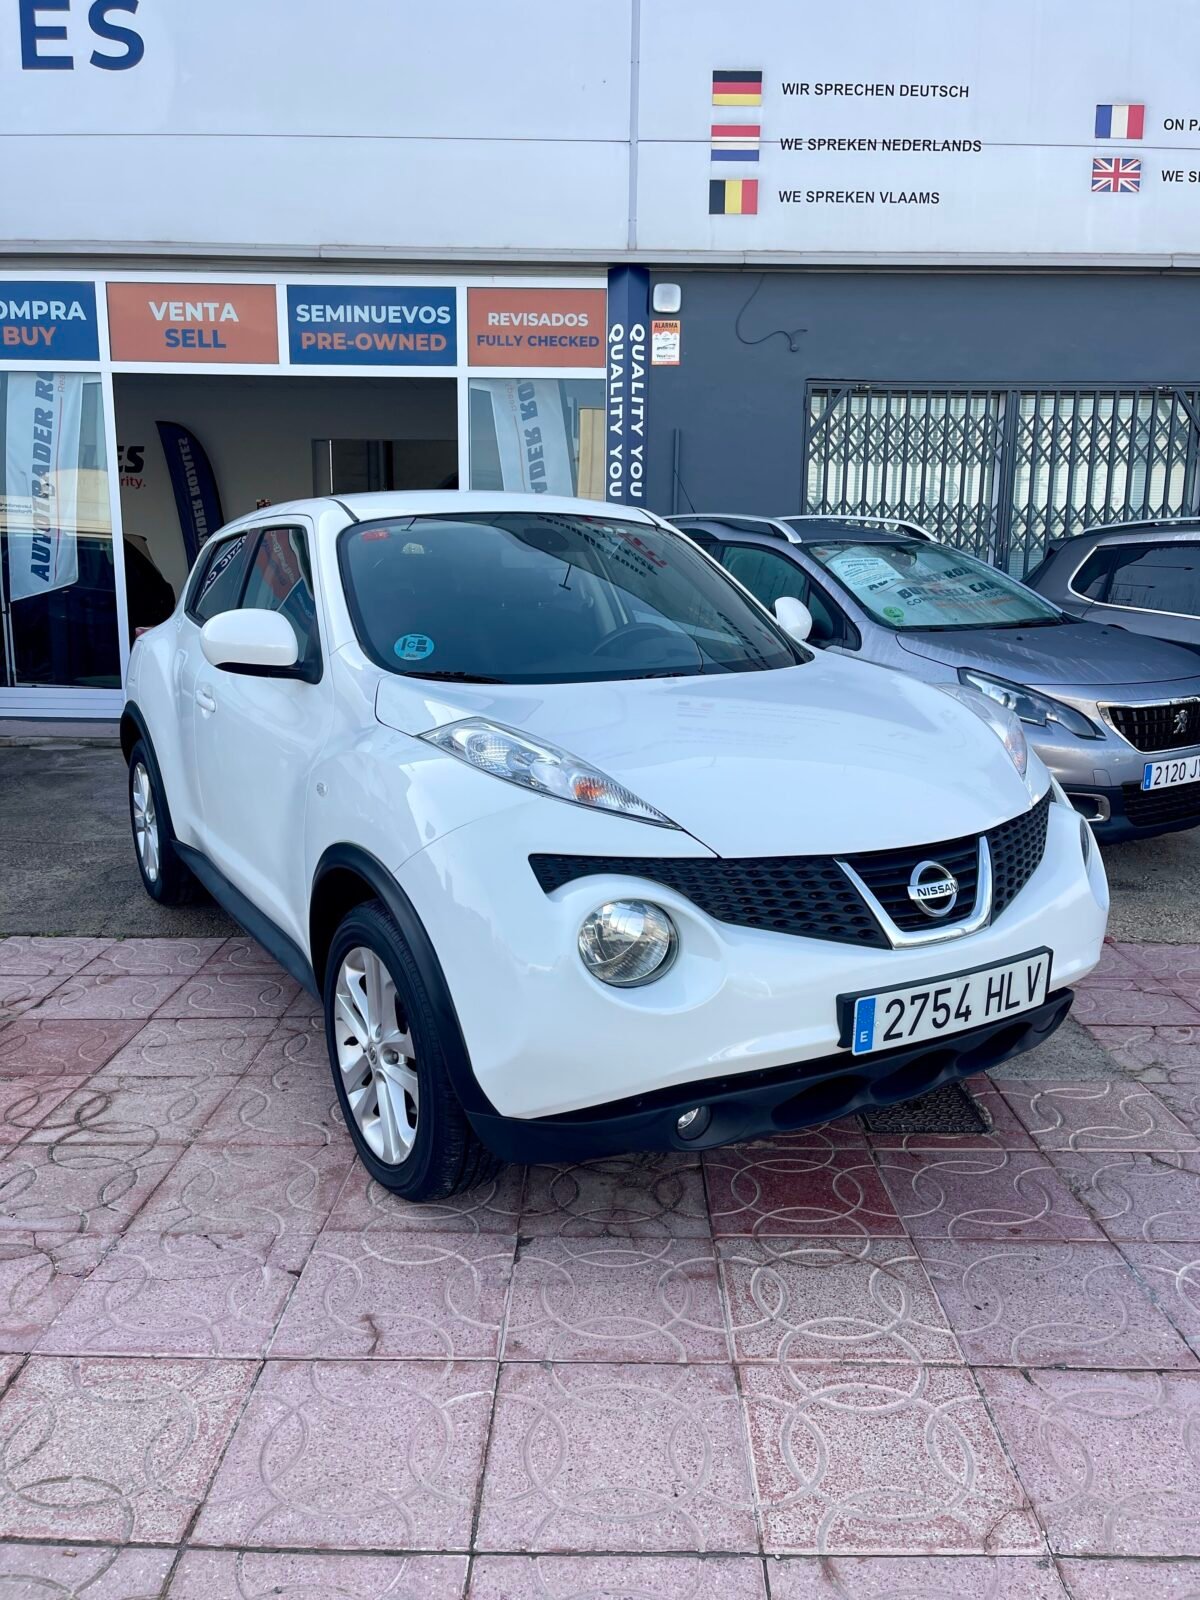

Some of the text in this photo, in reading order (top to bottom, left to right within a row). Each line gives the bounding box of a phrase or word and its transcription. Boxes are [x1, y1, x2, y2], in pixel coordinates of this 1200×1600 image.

[19, 0, 145, 71] ES
[781, 82, 969, 98] WIR SPRECHEN DEUTSCH
[1163, 118, 1200, 131] ON P
[780, 138, 982, 153] WE SPREKEN NEDERLANDS
[1162, 170, 1200, 183] WE S
[778, 190, 940, 205] WE SPREKEN VLAAMS
[149, 301, 240, 322] VENTA
[296, 304, 451, 324] SEMINUEVOS
[488, 312, 589, 327] REVISADOS
[3, 326, 56, 346] BUY
[165, 328, 227, 349] SELL
[301, 332, 447, 351] PRE-OWNED
[477, 334, 600, 348] FULLY CHECKED
[609, 323, 624, 497] QUALITY YOU
[630, 323, 645, 497] QUALITY YOU
[31, 407, 54, 583] AUTOTRADER
[1153, 758, 1200, 786] 2120 J
[916, 881, 958, 899] NISSAN
[883, 962, 1042, 1042] 2754 HLV
[859, 1031, 869, 1043] E
